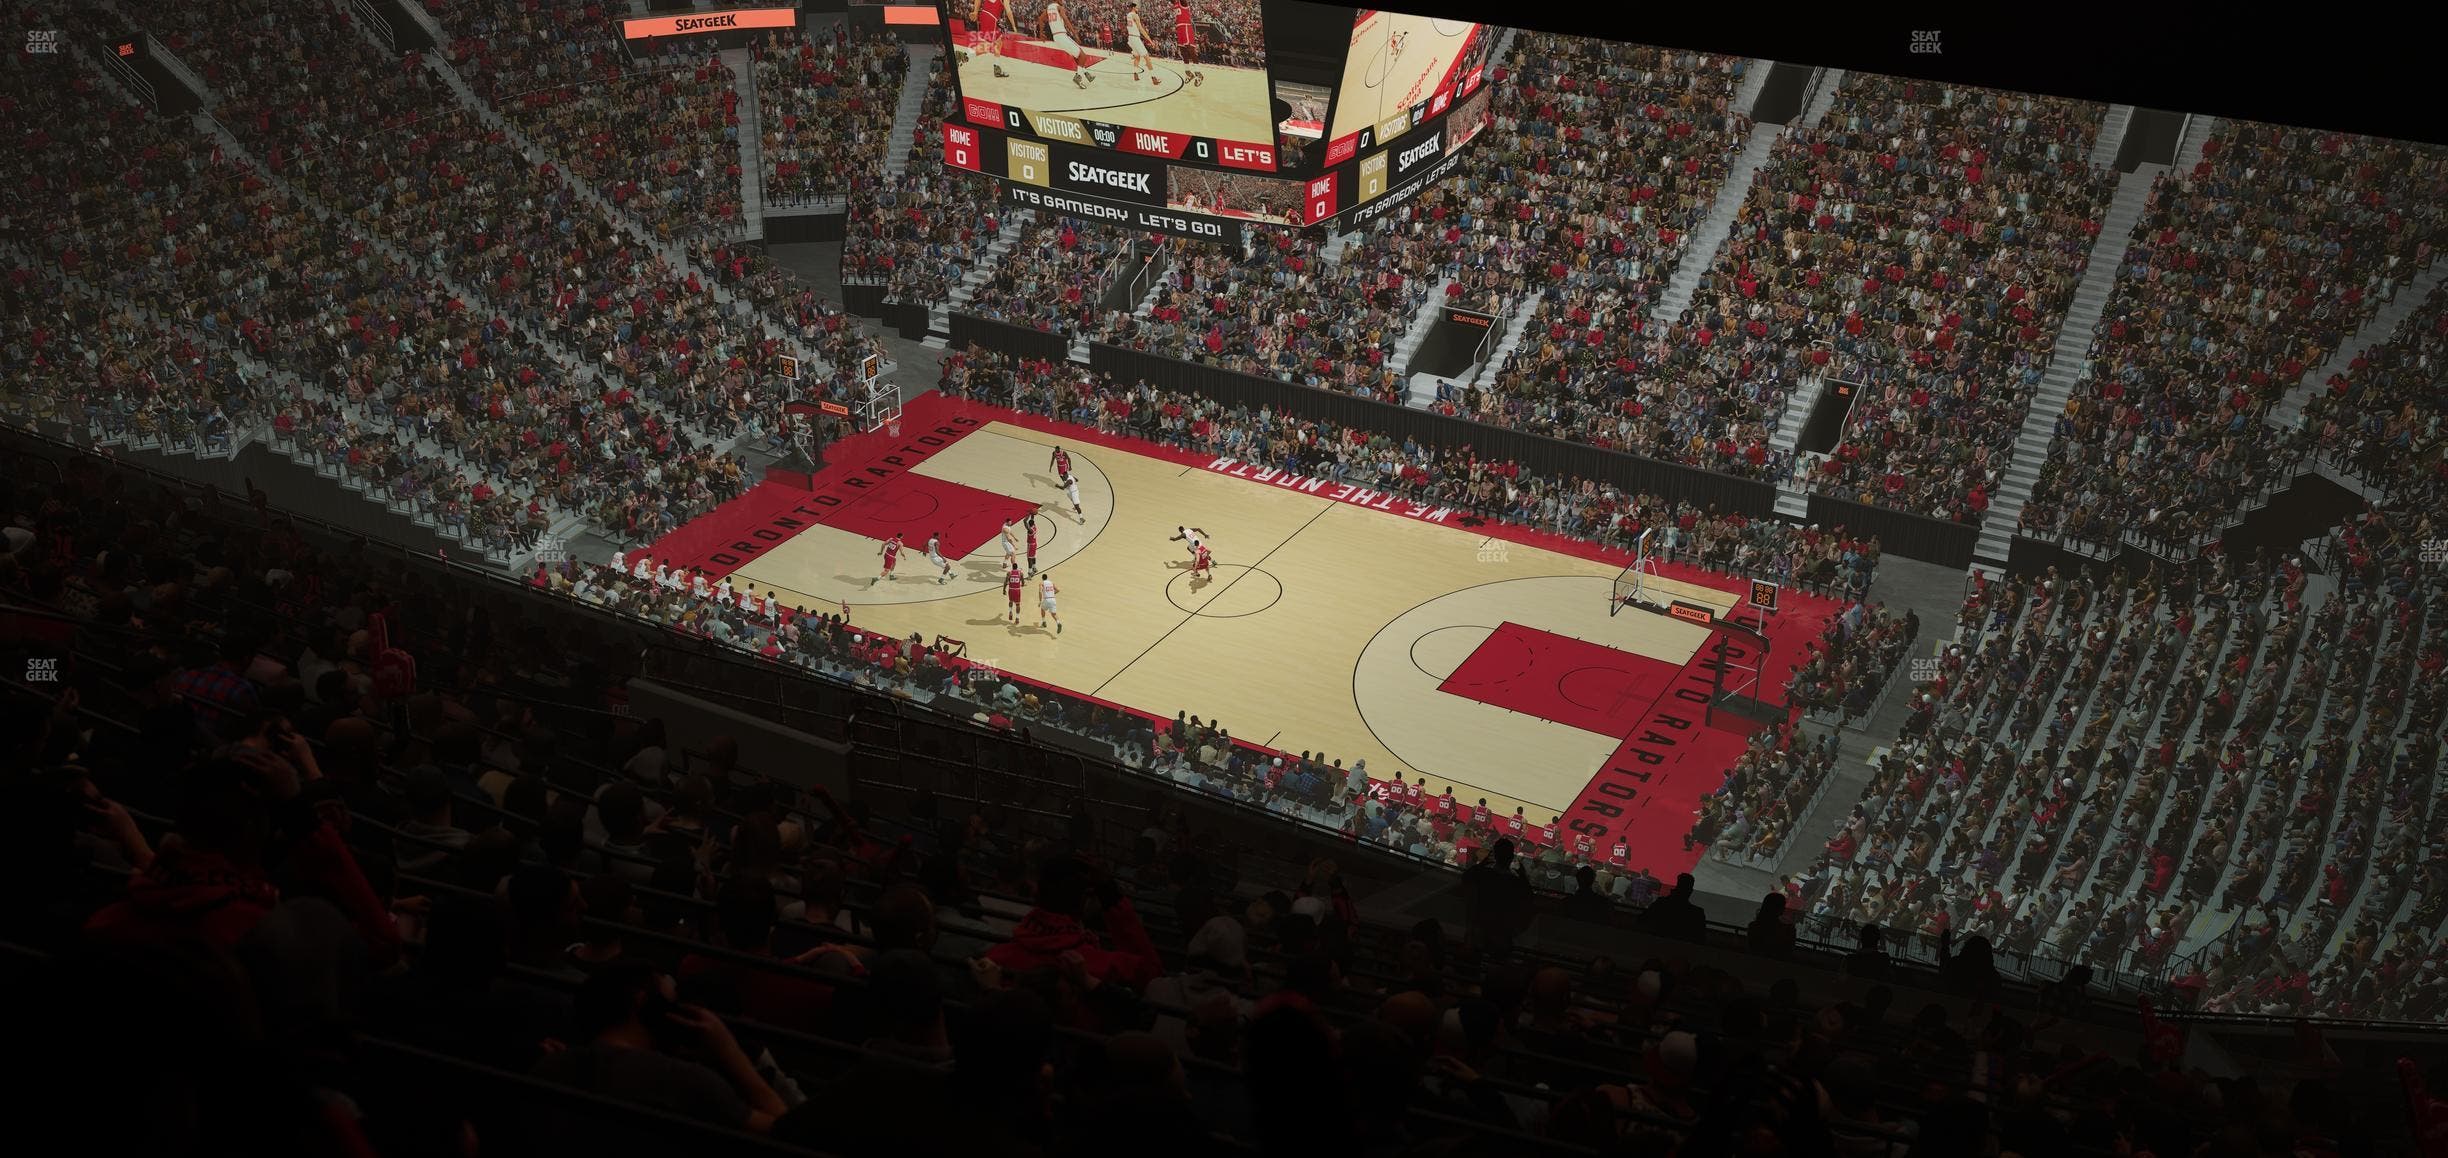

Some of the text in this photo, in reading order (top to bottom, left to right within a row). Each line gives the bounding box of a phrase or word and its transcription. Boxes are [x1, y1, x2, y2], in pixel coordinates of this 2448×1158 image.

[675, 14, 737, 32] SEATGEEK
[1009, 111, 1020, 127] 0
[1036, 116, 1082, 140] VISITORS
[950, 128, 971, 146] HOME
[1094, 129, 1115, 143] 00:00
[1135, 132, 1170, 154] HOME
[1361, 132, 1370, 148] 0
[956, 150, 967, 165] 0
[1010, 142, 1046, 162] VISITORS
[1196, 141, 1208, 158] 0
[1224, 146, 1272, 164] LET'S
[1398, 131, 1440, 172] SEATGEEK
[1022, 164, 1034, 180] 0
[1361, 153, 1386, 177] VISITORS
[1068, 161, 1151, 195] SEATGEEK
[1369, 179, 1377, 194] 0
[1311, 177, 1331, 198] HOME
[1353, 153, 1460, 224] IT'S GAMEDAY LET'S GO!
[1012, 187, 1222, 237] IT'S GAMEDAY LET'S GO!
[1316, 201, 1326, 217] 0
[1453, 313, 1489, 327] SEATGEEK
[844, 416, 979, 488] RAPTORS
[1329, 483, 1396, 510] THE
[1675, 607, 1706, 620] SEATGEEK
[1569, 713, 1692, 838] RAPTORS
[1613, 848, 1625, 857] 00
